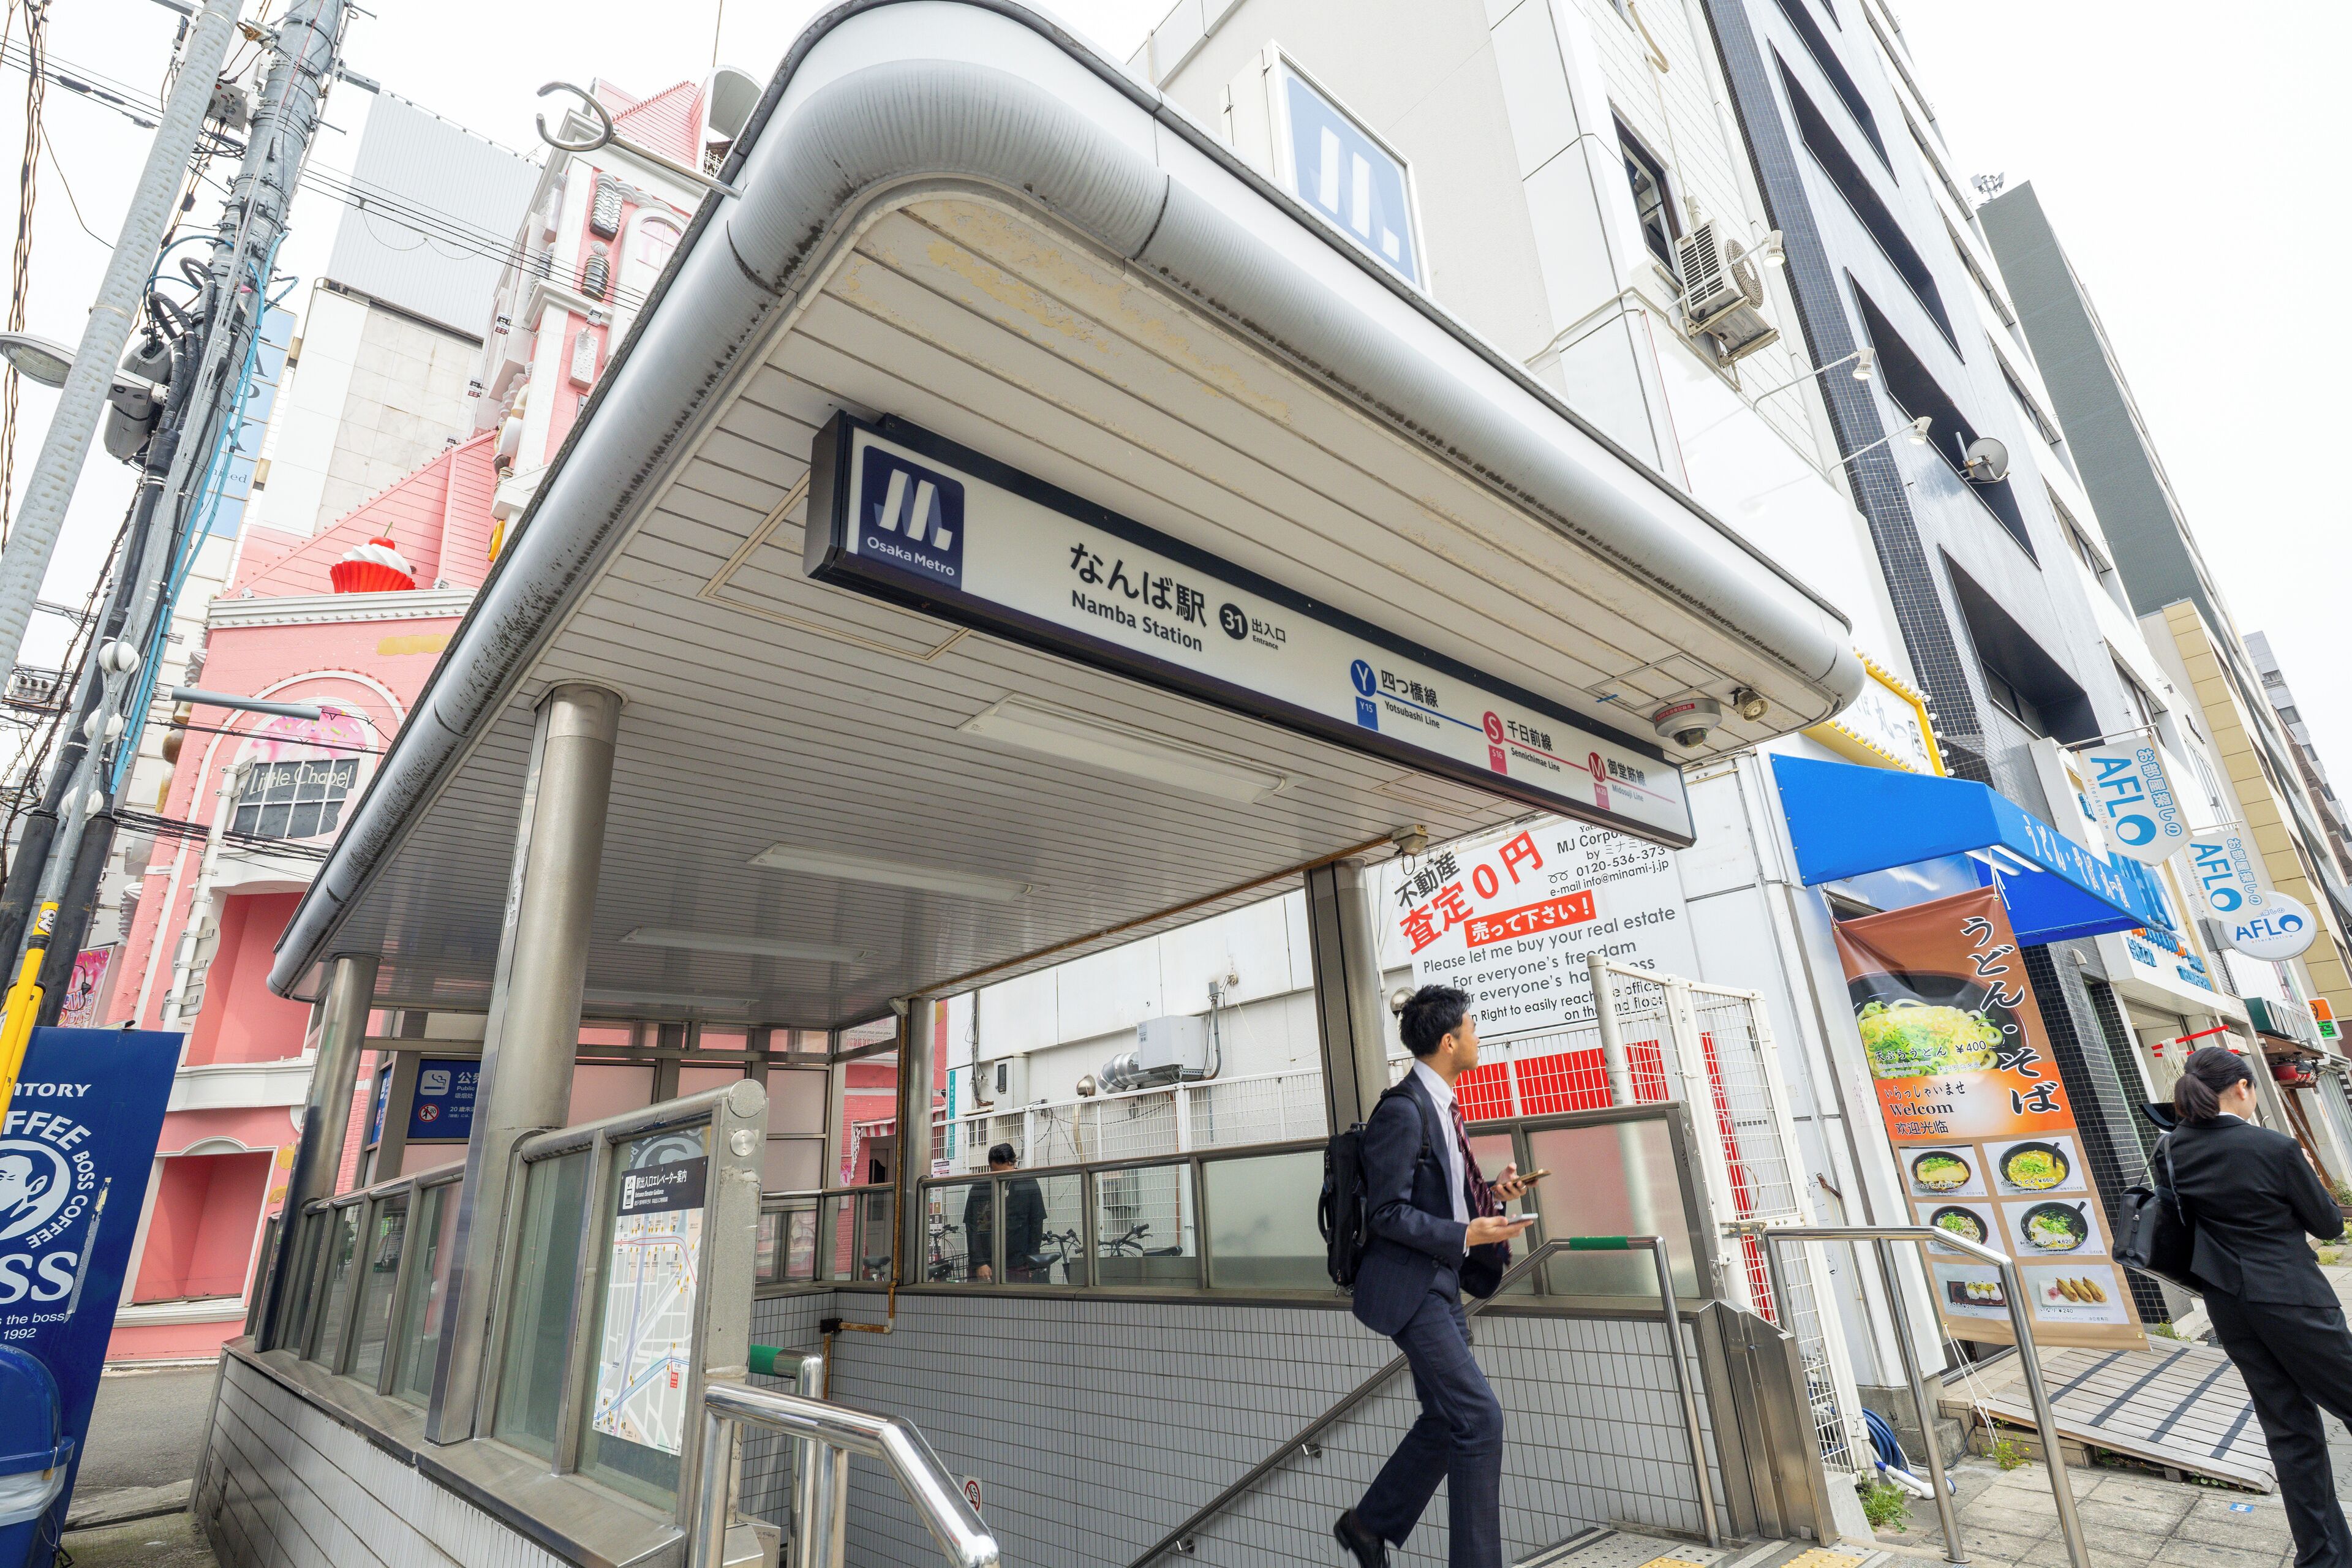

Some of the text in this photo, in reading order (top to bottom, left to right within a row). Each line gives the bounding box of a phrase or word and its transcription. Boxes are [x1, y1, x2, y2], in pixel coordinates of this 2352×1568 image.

[867, 537, 955, 576] Osaka Metro
[1071, 543, 1207, 627] なんば駅
[1072, 590, 1202, 652] Namba Station
[1225, 609, 1243, 634] 31
[1252, 618, 1286, 643] 出入口
[1253, 635, 1279, 650] Entrance
[1355, 663, 1369, 692] Y
[1381, 669, 1438, 708] 四つ橋線
[1360, 702, 1373, 713] Y15
[1384, 701, 1440, 728] Yotsubashi Line
[1488, 716, 1499, 740] S
[1507, 720, 1553, 752] 千日前線
[1492, 748, 1502, 759] S16
[1511, 747, 1561, 772] Sennichimae Line
[1590, 755, 1605, 779] M
[249, 764, 353, 795] Little Chapel
[1607, 758, 1646, 786] 御堂筋線
[1596, 786, 1607, 796] M20
[1612, 784, 1644, 802] Midosuji Line
[2087, 778, 2109, 830] after&follow
[2090, 757, 2157, 846] AFLO
[2136, 748, 2182, 837] お部屋探しの
[1557, 831, 1622, 854] MJ Corpo
[1586, 850, 1600, 861] by
[1576, 846, 1666, 876] 0120-536-373
[2226, 837, 2262, 905] お部屋探しの
[1395, 851, 1460, 908] 不動産
[1550, 859, 1669, 897] e-mail info@minami-j.jp
[2190, 843, 2242, 912] AFLO
[1424, 907, 1676, 973] Please let me buy your real estate
[2236, 914, 2303, 941] AFLO
[1452, 975, 1472, 988] For
[1481, 1006, 1507, 1021] Right
[1510, 1005, 1521, 1016] to
[1525, 998, 1557, 1012] easily
[1561, 990, 1594, 1006] reach
[1625, 981, 1660, 995] office
[1564, 1010, 1579, 1020] on
[1583, 1006, 1598, 1017] th
[1960, 916, 2061, 1116] うどん・そば
[1875, 1040, 1987, 1061] 天ぷらうどん ¥400
[1885, 1081, 1966, 1100] いらっしゃいませ
[1890, 1102, 1954, 1117] Welcom
[1896, 1120, 1949, 1135] 欢迎光临
[636, 1169, 687, 1189] 駅出入口エレベーター案内
[26, 1150, 94, 1249] BOSS COFFEE
[6, 1314, 28, 1325] the
[32, 1313, 65, 1323] boss
[3, 1328, 37, 1340] 1992
